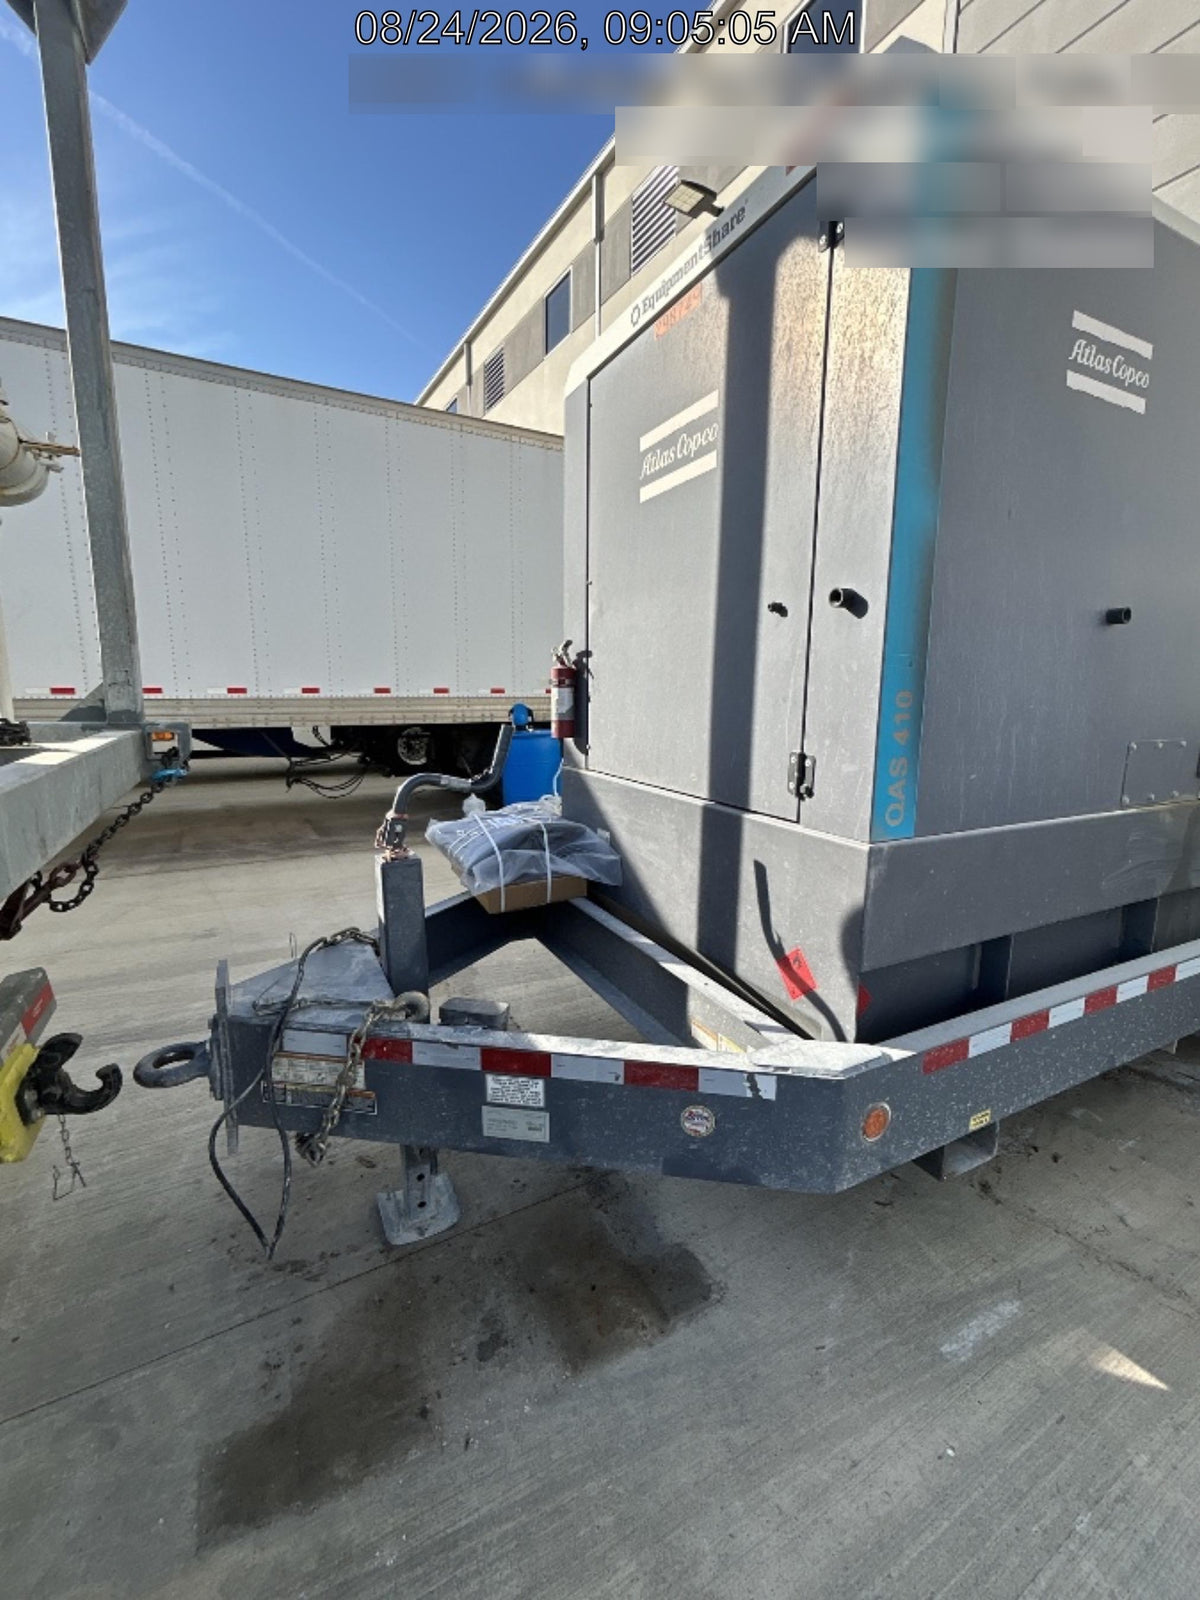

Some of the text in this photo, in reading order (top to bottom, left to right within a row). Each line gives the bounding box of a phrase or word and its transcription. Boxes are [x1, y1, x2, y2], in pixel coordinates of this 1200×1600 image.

[641, 205, 746, 316] EquipmentShare
[1067, 338, 1150, 389] Atlas Copco
[639, 422, 719, 481] Atlas Copco
[884, 689, 913, 827] QAS 410
